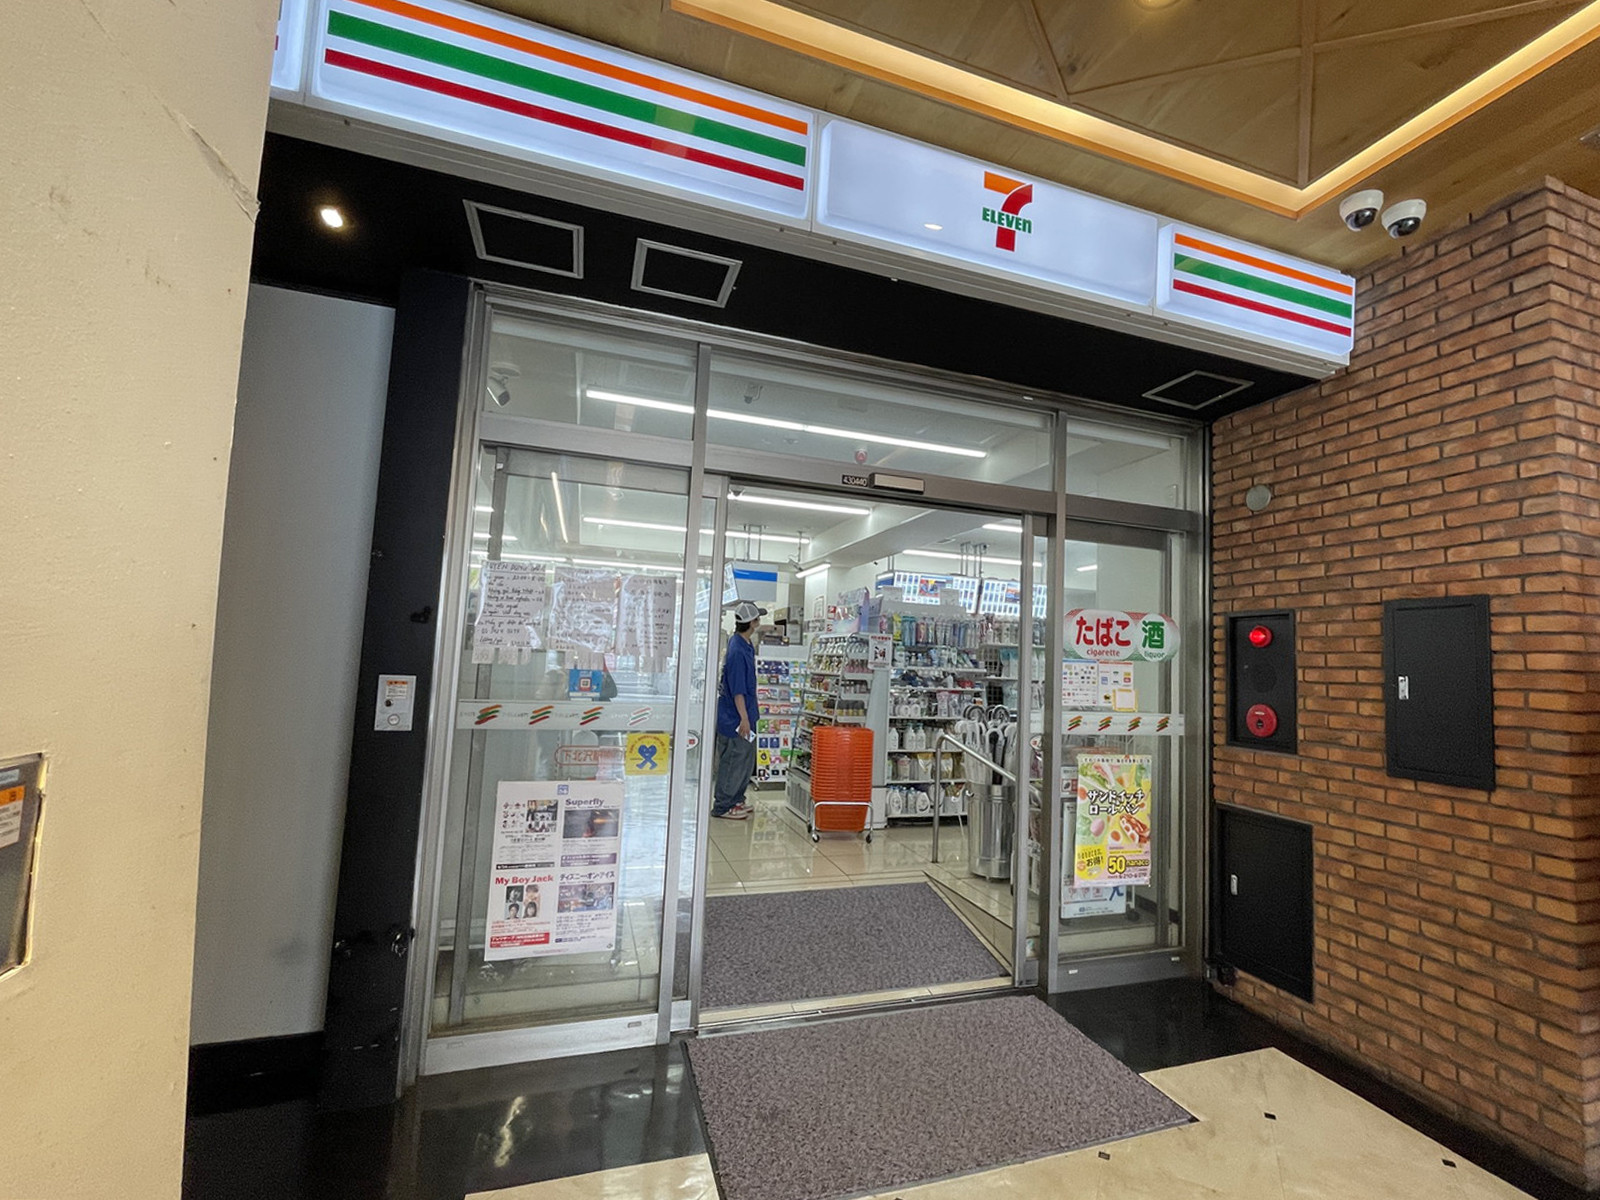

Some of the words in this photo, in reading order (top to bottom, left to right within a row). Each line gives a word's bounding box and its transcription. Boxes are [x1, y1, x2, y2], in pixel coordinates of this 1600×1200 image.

[983, 171, 1033, 252] 7
[1076, 616, 1131, 647] たばこ
[1141, 620, 1165, 649] 酒
[1086, 647, 1121, 657] cigarette
[1144, 651, 1165, 659] liquor
[565, 797, 605, 807] Superfly
[1087, 788, 1145, 804] サンドイッチ
[1089, 803, 1141, 816] ロールパン
[1108, 855, 1127, 875] 50
[495, 877, 510, 886] My
[511, 875, 531, 885] Boy
[532, 874, 554, 883] Jack
